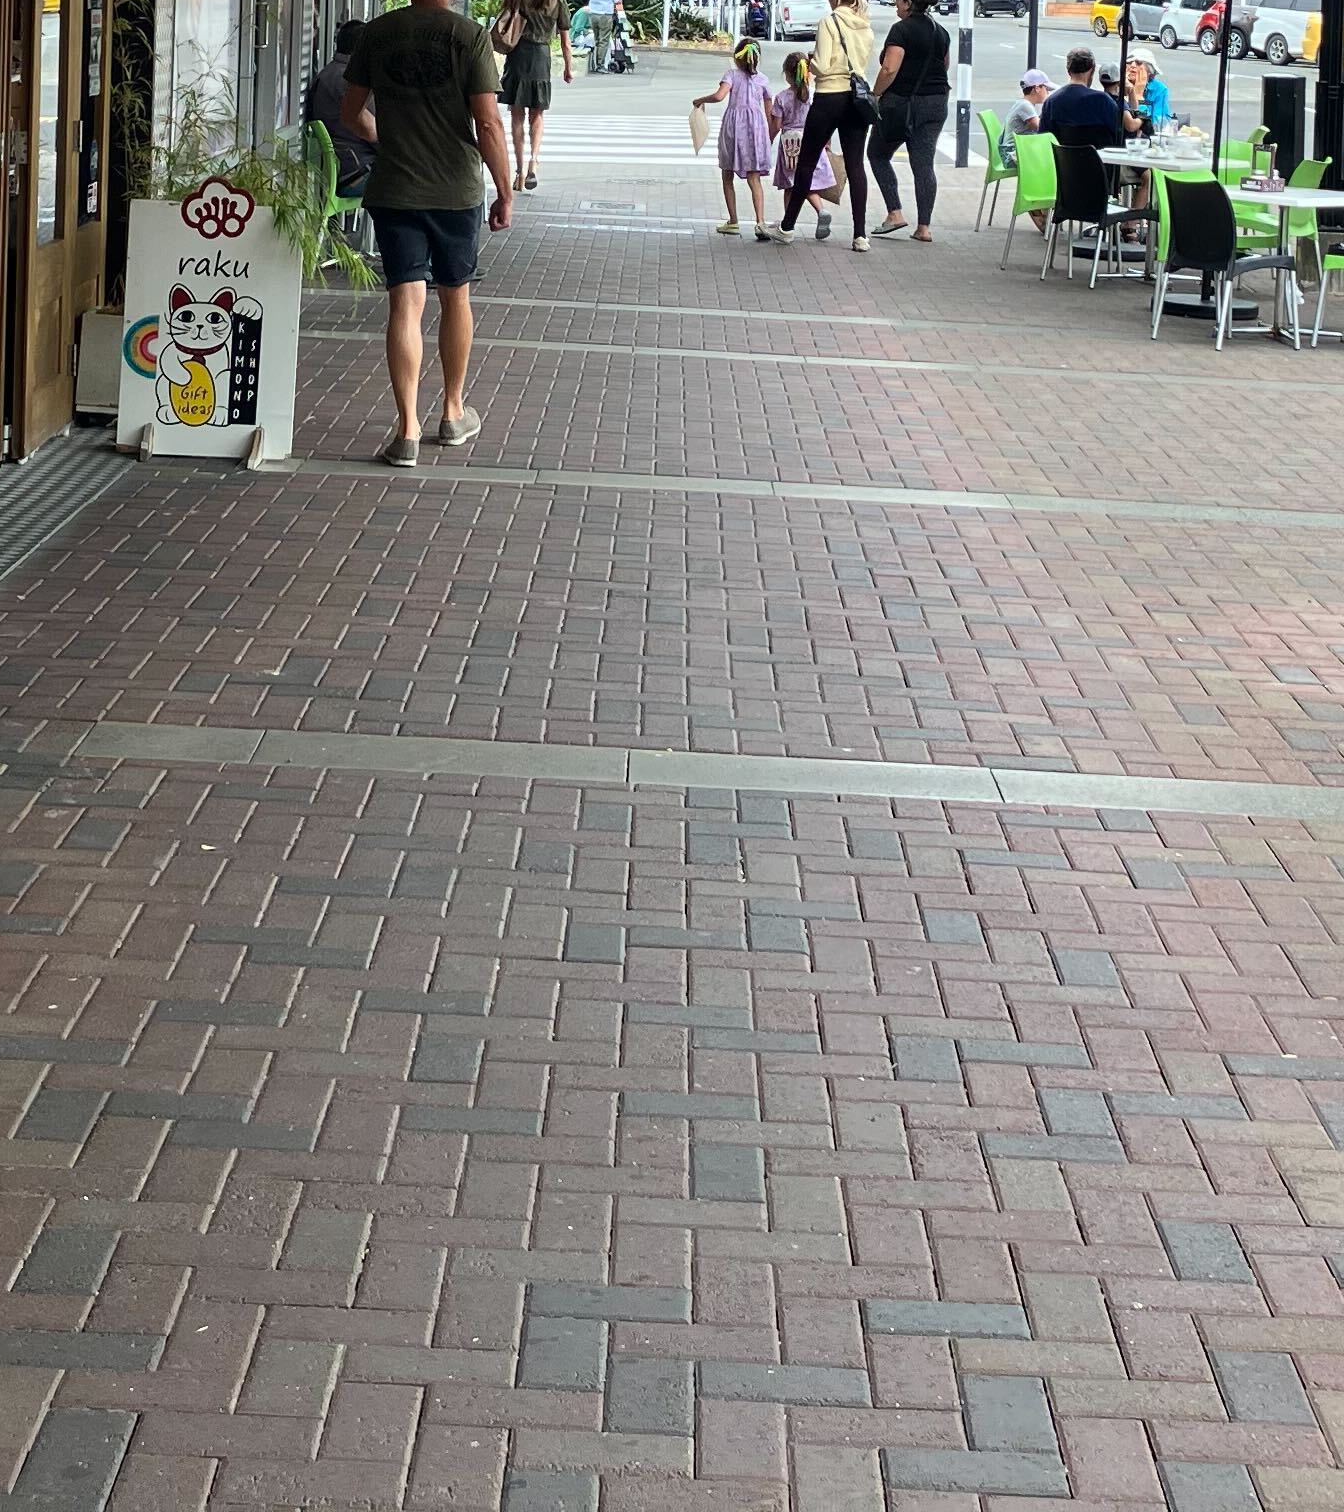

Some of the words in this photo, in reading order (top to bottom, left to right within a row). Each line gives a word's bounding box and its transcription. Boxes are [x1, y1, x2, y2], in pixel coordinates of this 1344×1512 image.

[178, 249, 250, 279] raku
[232, 321, 246, 420] KIMONO
[246, 339, 257, 402] SHOP
